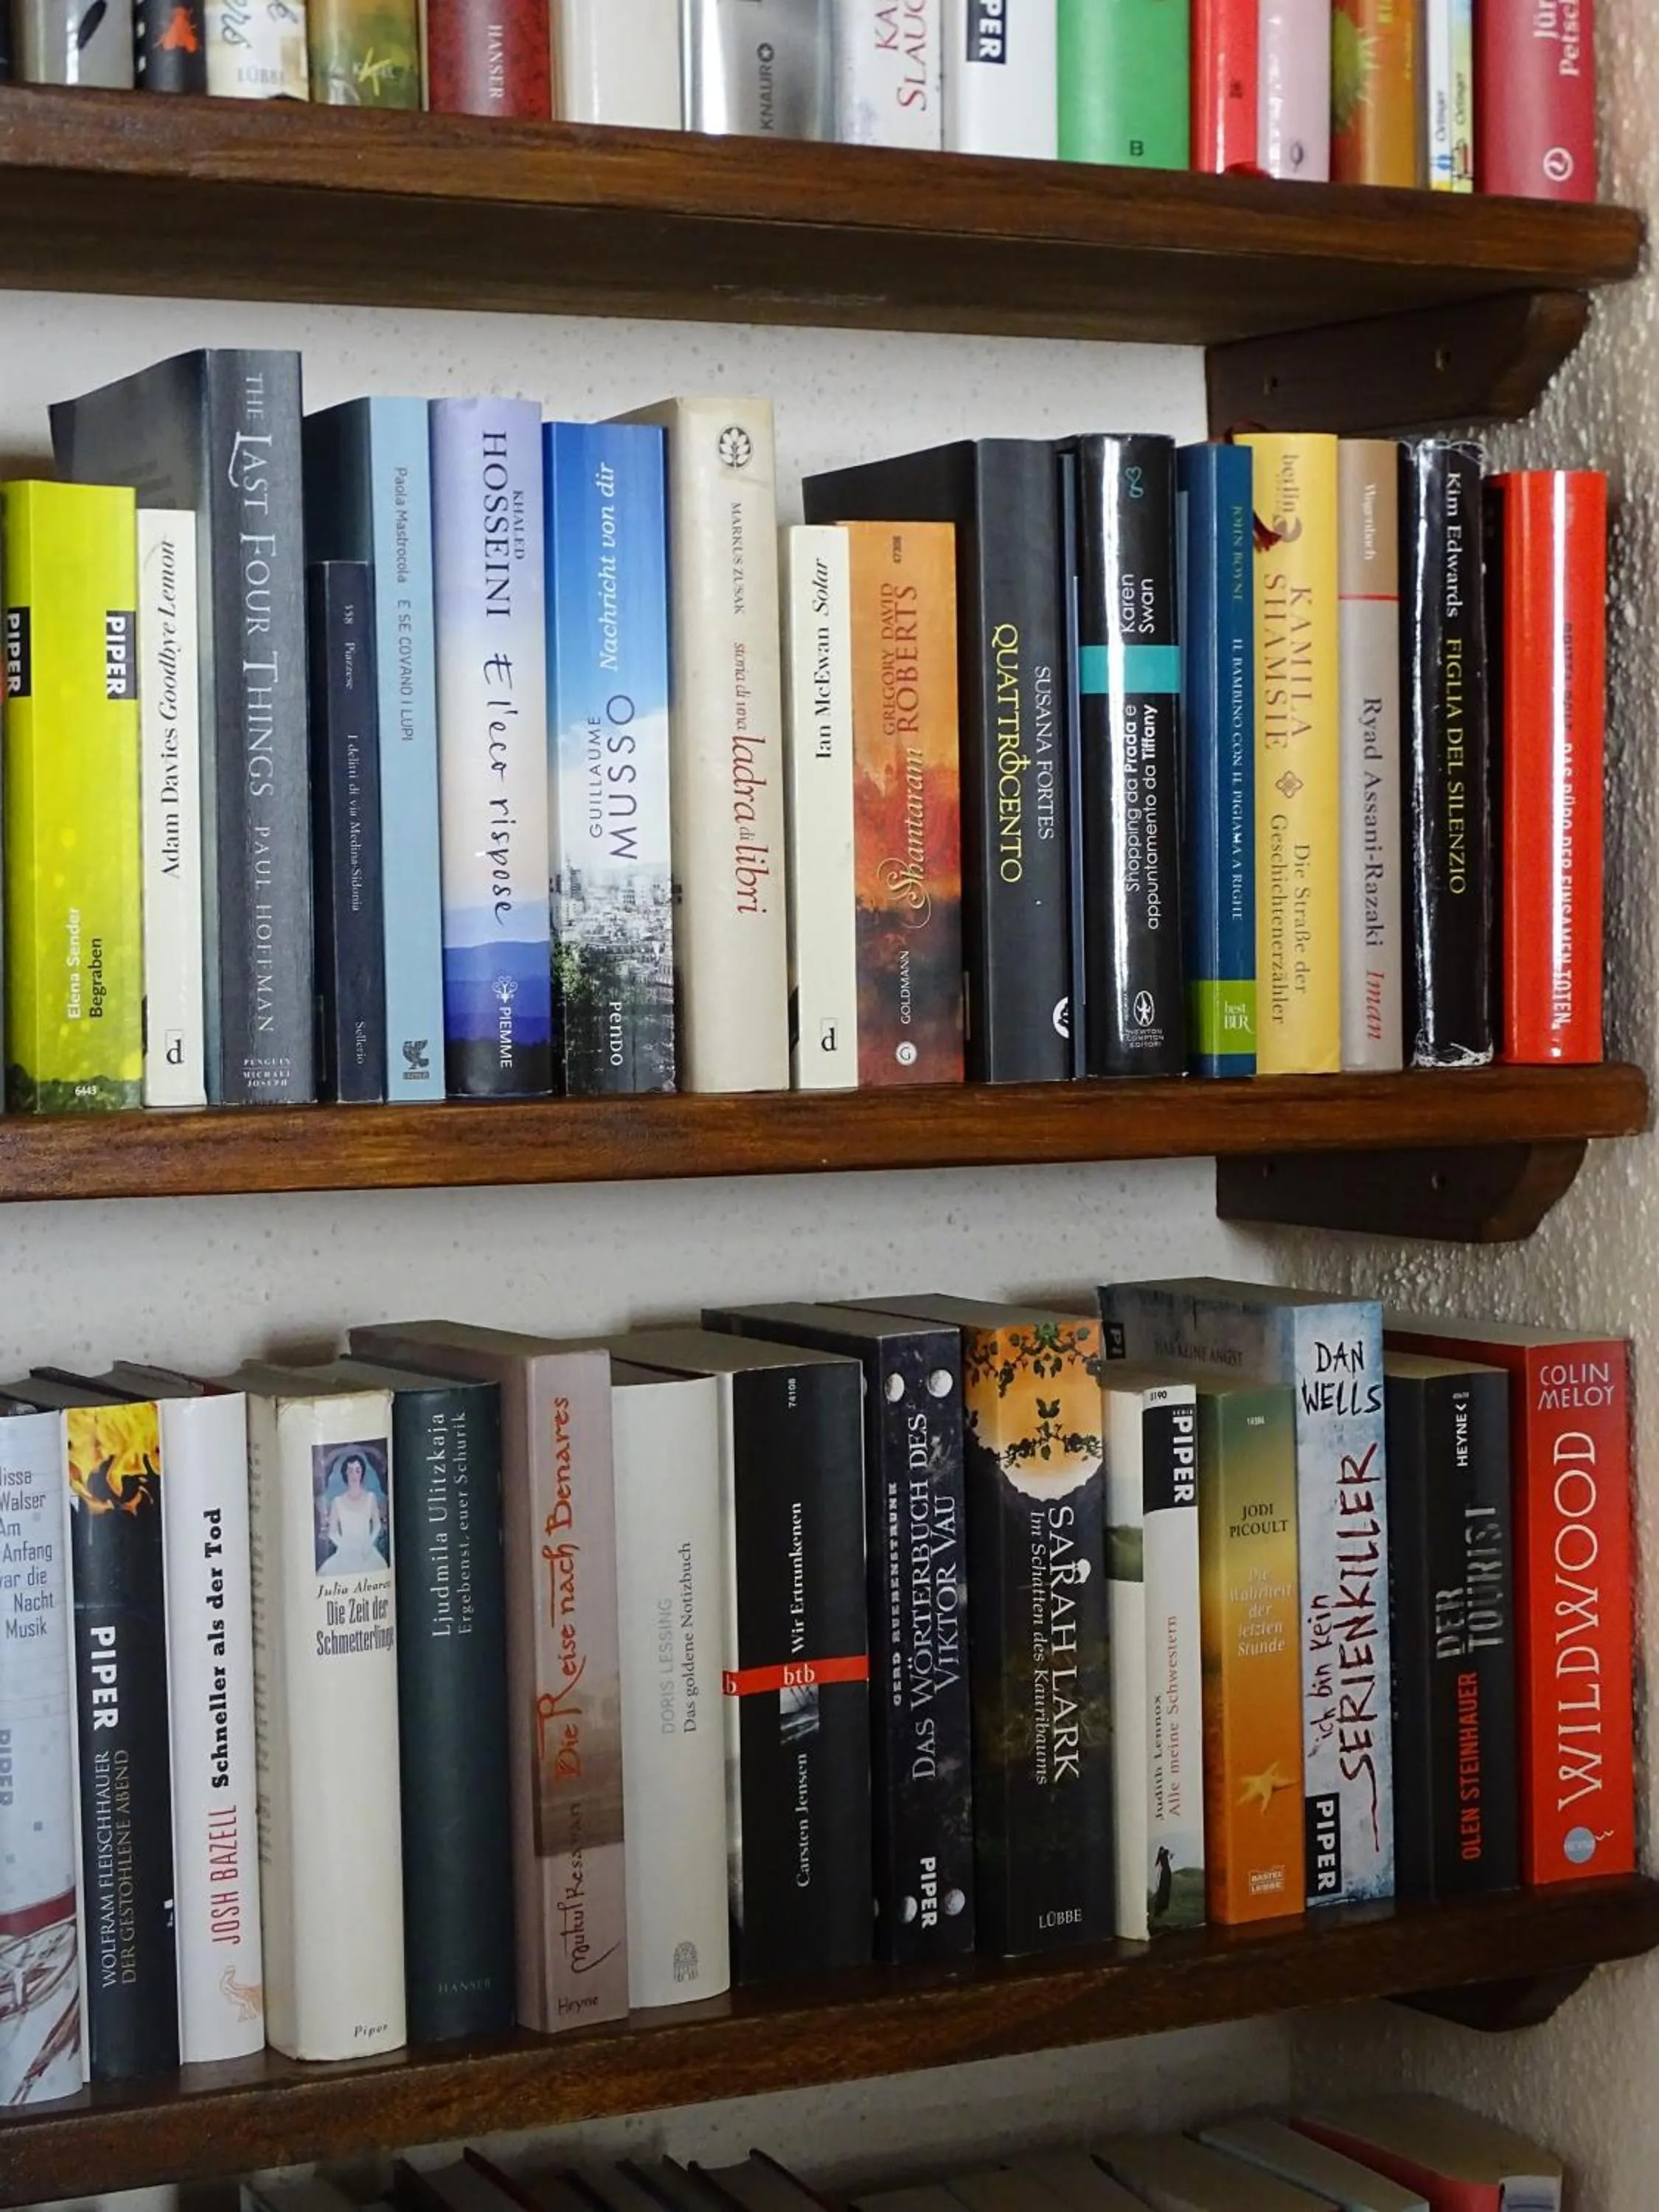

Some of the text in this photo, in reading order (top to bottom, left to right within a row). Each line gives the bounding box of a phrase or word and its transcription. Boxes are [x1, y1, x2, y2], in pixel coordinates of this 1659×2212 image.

[487, 24, 505, 100] HANSER
[759, 65, 775, 131] KNAUR
[245, 372, 264, 420] THE
[228, 428, 272, 515] LAST
[394, 467, 408, 506] Paola
[483, 431, 511, 619] HOSSEINI
[512, 490, 525, 560] KHALED
[1281, 454, 1300, 512] berlin
[238, 531, 277, 637] FOUR
[395, 509, 409, 583] Mastrocola
[397, 599, 410, 608] E
[595, 462, 619, 672] Nachricht von dir
[1121, 574, 1135, 633] Karen
[1138, 578, 1155, 634] Swan
[1231, 505, 1244, 602] JOHN BOYNE
[6, 613, 23, 694] PIPER
[106, 615, 127, 695] PIPER
[397, 613, 411, 632] SE
[398, 636, 412, 696] COVANO
[813, 558, 832, 759] Ian McEwan Solar
[880, 582, 897, 736] GREGORY DAVID
[894, 585, 919, 733] ROBERTS
[1263, 572, 1288, 751] SHAMSIE
[1290, 587, 1313, 738] KAMILA
[1445, 471, 1467, 894] Kim Edwards FIGLIA DEL SILENZIO
[156, 540, 182, 880] Adam Davies Goodbye Lemon
[243, 650, 279, 797] THINGS
[400, 709, 414, 741] LUPI
[487, 700, 519, 780] l'eco
[731, 501, 769, 915] MARKUS ZUSAK storia di una ladra di libri
[992, 622, 1029, 883] QUATTROCENTO
[1034, 665, 1054, 841] SUSANA FORTES
[588, 716, 604, 838] GUILLAUME
[607, 695, 638, 860] MUSSO
[1123, 705, 1142, 892] Shopping da Prada e
[1141, 704, 1161, 931] appuntamento da Tiffany
[253, 826, 273, 889] PAUL
[486, 799, 516, 925] rispose
[877, 747, 932, 930] Shantaram
[1357, 697, 1385, 1041] Ryad Assani-Razaki Iman
[66, 908, 81, 1020] Elena Sender
[90, 938, 108, 1018] Begraben
[256, 903, 275, 1034] HOFFMAN
[1269, 813, 1288, 1025] Geschichtenerzähler
[1293, 844, 1311, 995] Die Straße der
[498, 1006, 512, 1068] PIEMME
[899, 950, 911, 1024] GOLDMANN
[1301, 1378, 1382, 1416] WELLS
[1314, 1341, 1365, 1373] DAN
[1536, 1386, 1615, 1411] MELOY
[1538, 1361, 1609, 1387] COLIN
[1172, 1416, 1194, 1503] PIPER
[1456, 1413, 1469, 1467] HEYNE
[3, 1540, 52, 1563] Anfang
[426, 1414, 451, 1638] Ljudmila Ulitzkaja
[451, 1411, 473, 1635] Ergebenst, euer Schurik
[1229, 1520, 1289, 1539] PICOULT
[1242, 1503, 1274, 1520] JODI
[6, 1615, 47, 1639] Musik
[14, 1590, 55, 1614] Nacht
[326, 1595, 389, 1626] Die Zeit der
[678, 1542, 698, 1733] Das goldene Notizbuch
[787, 1501, 805, 1655] Wir Ertrunkenen
[888, 1483, 902, 1707] GERD RUEBENSTRUNK
[906, 1414, 938, 1781] DAS WÖRTERBUCH DES
[929, 1495, 961, 1695] VIKTOR VAU
[1435, 1587, 1466, 1660] DER
[1464, 1506, 1504, 1655] TOURIST
[1552, 1431, 1603, 1812] WILDWOOD
[91, 1625, 118, 1731] PIPER
[204, 1507, 231, 1789] Schneller als der Tod
[656, 1599, 675, 1734] DORIS LESSING
[782, 1663, 815, 1687] btb
[1029, 1510, 1051, 1785] Im Schatten des Kauribaums
[1048, 1505, 1079, 1782] SARAH LARK
[1238, 1637, 1287, 1659] Stunde
[1337, 1442, 1381, 1843] SERIENKILLER
[1152, 1695, 1165, 1820] Judith Lennox
[1166, 1616, 1181, 1818] Alle meine Schwestern
[1458, 1672, 1482, 1860] OLEN STEINHAUER
[94, 1753, 118, 1989] WOLFRAM FLEISCHHAUER
[113, 1749, 137, 1984] DER GESTOHLENE ABEND
[209, 1804, 242, 1947] JOSH BAZELL
[794, 1753, 813, 1888] Carsten Jensen
[1315, 1799, 1337, 1891] PIPER
[919, 1856, 939, 1928] PIPER
[353, 2024, 389, 2038] Piper
